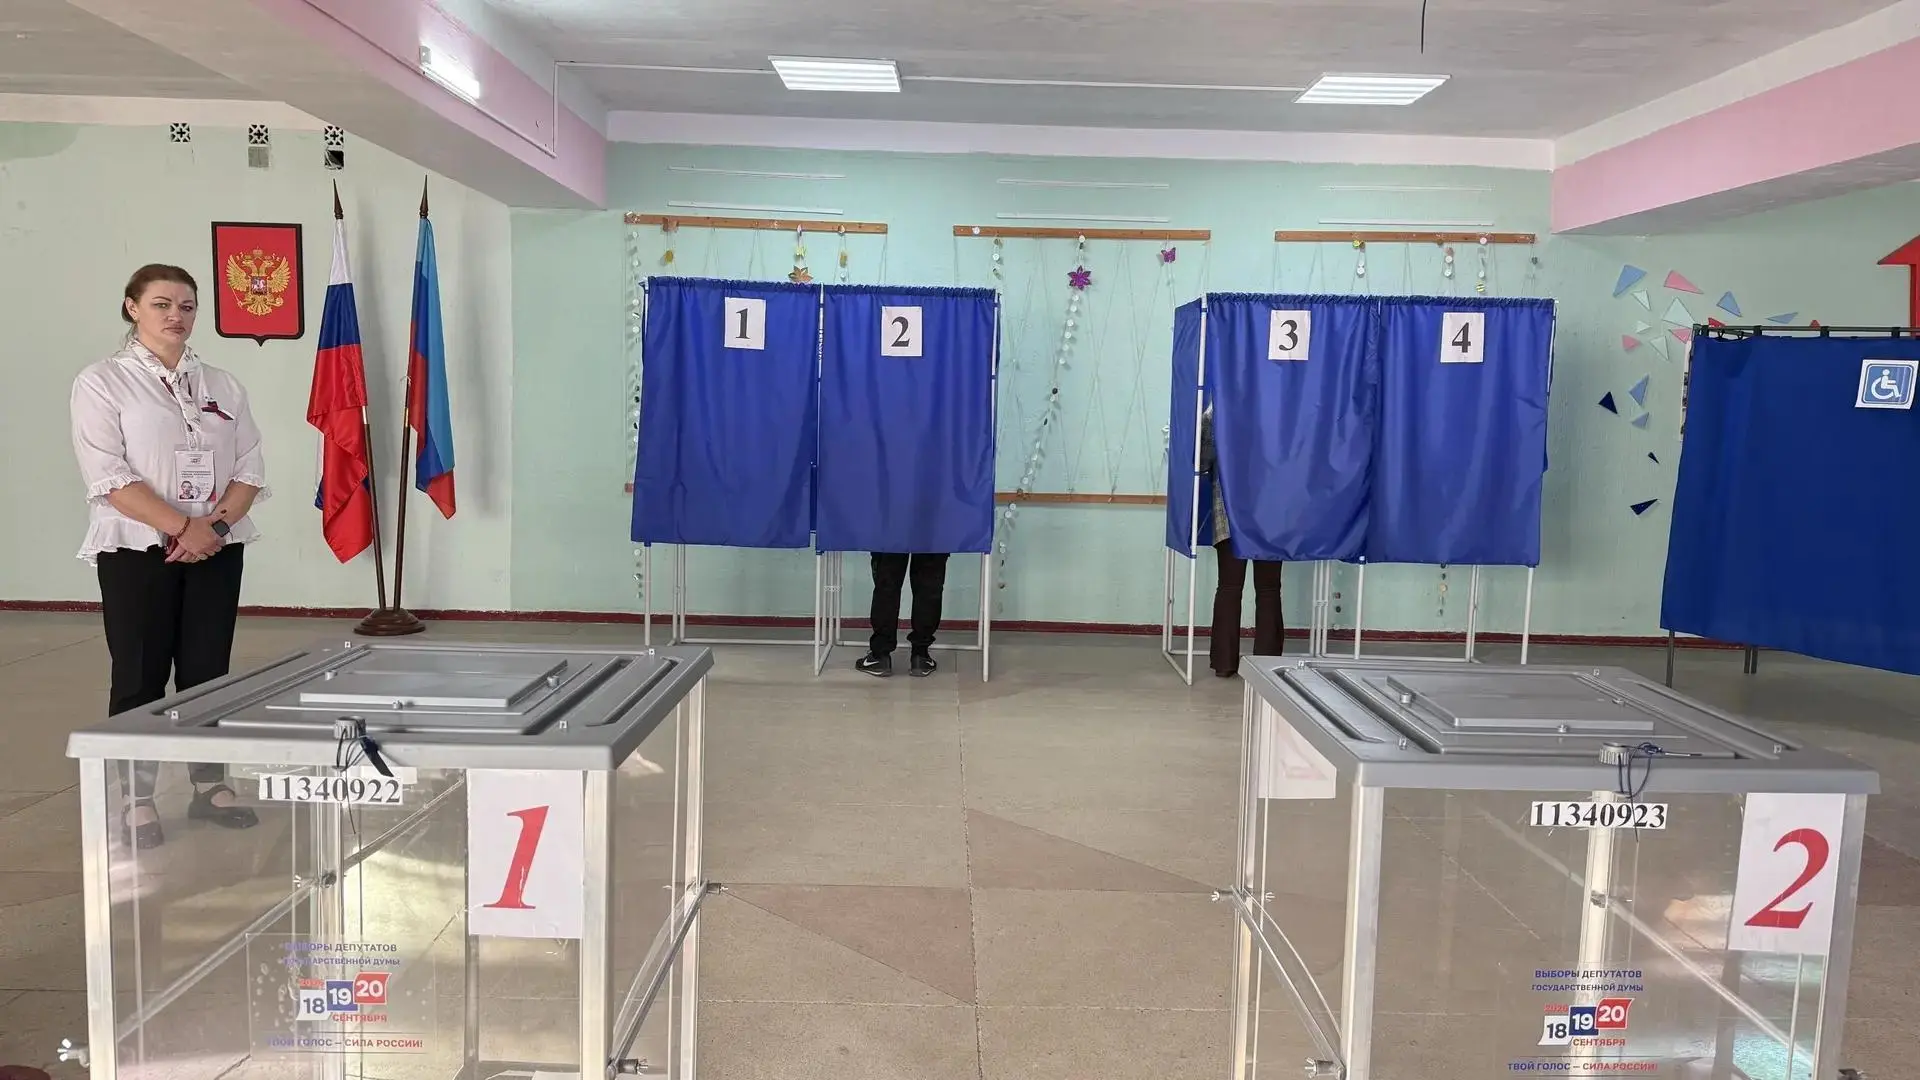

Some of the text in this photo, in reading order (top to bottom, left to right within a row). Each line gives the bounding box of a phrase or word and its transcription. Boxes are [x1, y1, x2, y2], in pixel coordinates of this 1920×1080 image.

[735, 307, 750, 339] 1
[891, 316, 910, 348] 2
[1278, 319, 1298, 351] 3
[1451, 322, 1472, 353] 4
[263, 775, 401, 803] 11340922
[1533, 802, 1665, 828] 11340923
[483, 805, 550, 909] 1
[1743, 827, 1830, 929] 2
[284, 943, 397, 953] ОРЫ ДЕПУТАТОВ
[373, 957, 400, 966] ДУМЫ
[1532, 983, 1643, 992] ГОСУДАРСТВЕННОЙ ДУМЫ
[1535, 970, 1642, 980] ВЫБОРЫ ДЕПУТАТОВ
[303, 980, 384, 1014] 18 19 20
[332, 1014, 387, 1023] СЕНТЯБРЯ
[1546, 1005, 1625, 1039] 18 19 20
[298, 1038, 333, 1047] ГОЛОС
[344, 1039, 374, 1047] СИЛА
[376, 1039, 423, 1048] РОССИИ!
[1573, 1038, 1626, 1046] СЕНТЯБРЯ
[1508, 1061, 1534, 1070] ТВОЙ
[1537, 1062, 1570, 1070] ГОЛОС
[1582, 1062, 1610, 1070] СИЛА
